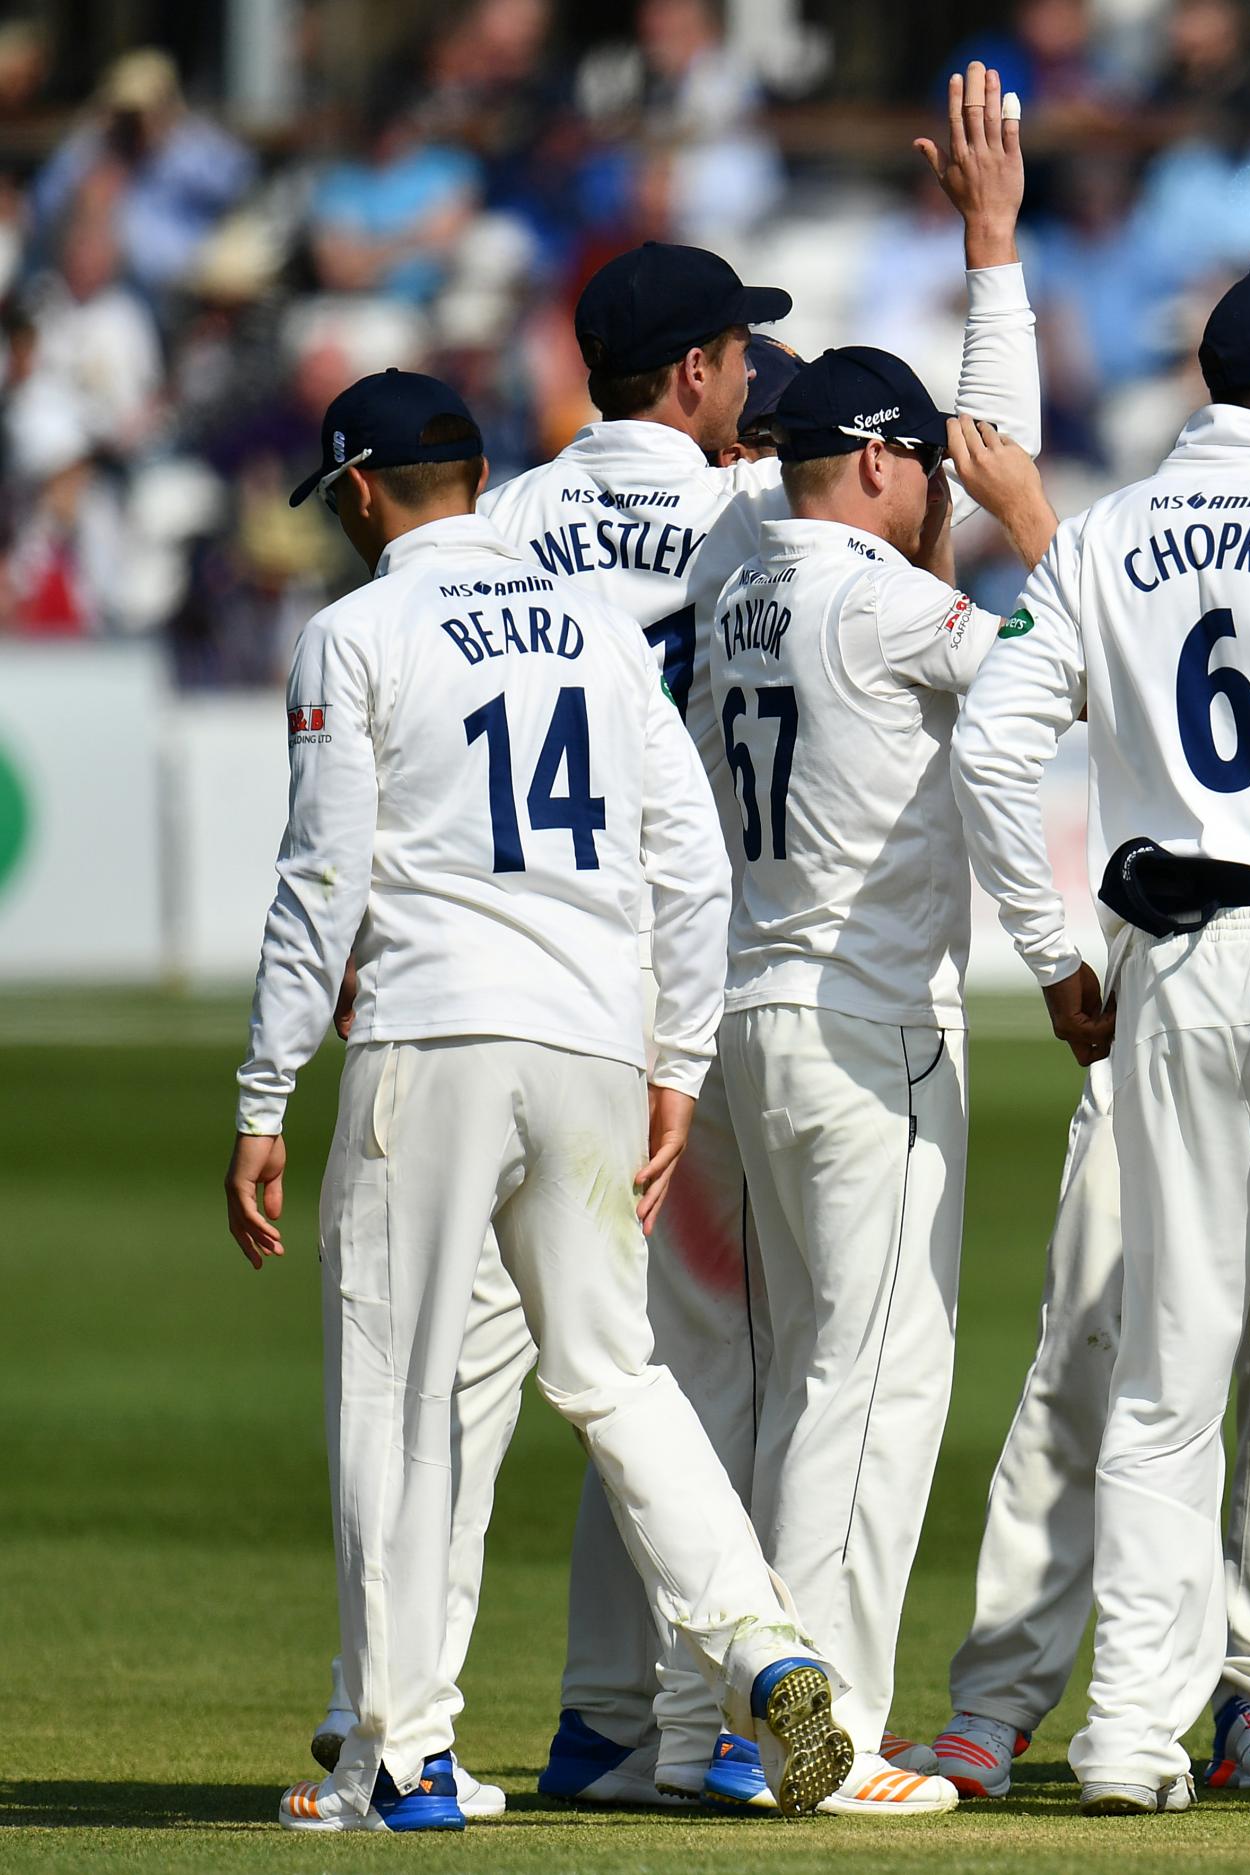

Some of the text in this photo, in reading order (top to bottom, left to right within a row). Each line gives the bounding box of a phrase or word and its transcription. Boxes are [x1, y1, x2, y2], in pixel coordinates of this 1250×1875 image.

[853, 406, 900, 431] Seetec
[561, 489, 595, 504] MS
[1150, 496, 1184, 511] MS
[529, 519, 708, 579] WESTLEY
[847, 536, 868, 556] MS
[438, 585, 473, 598] MS
[440, 606, 585, 666] BEARD
[720, 597, 792, 663] TAYLOR
[462, 686, 607, 874] 14
[721, 685, 799, 863] 67
